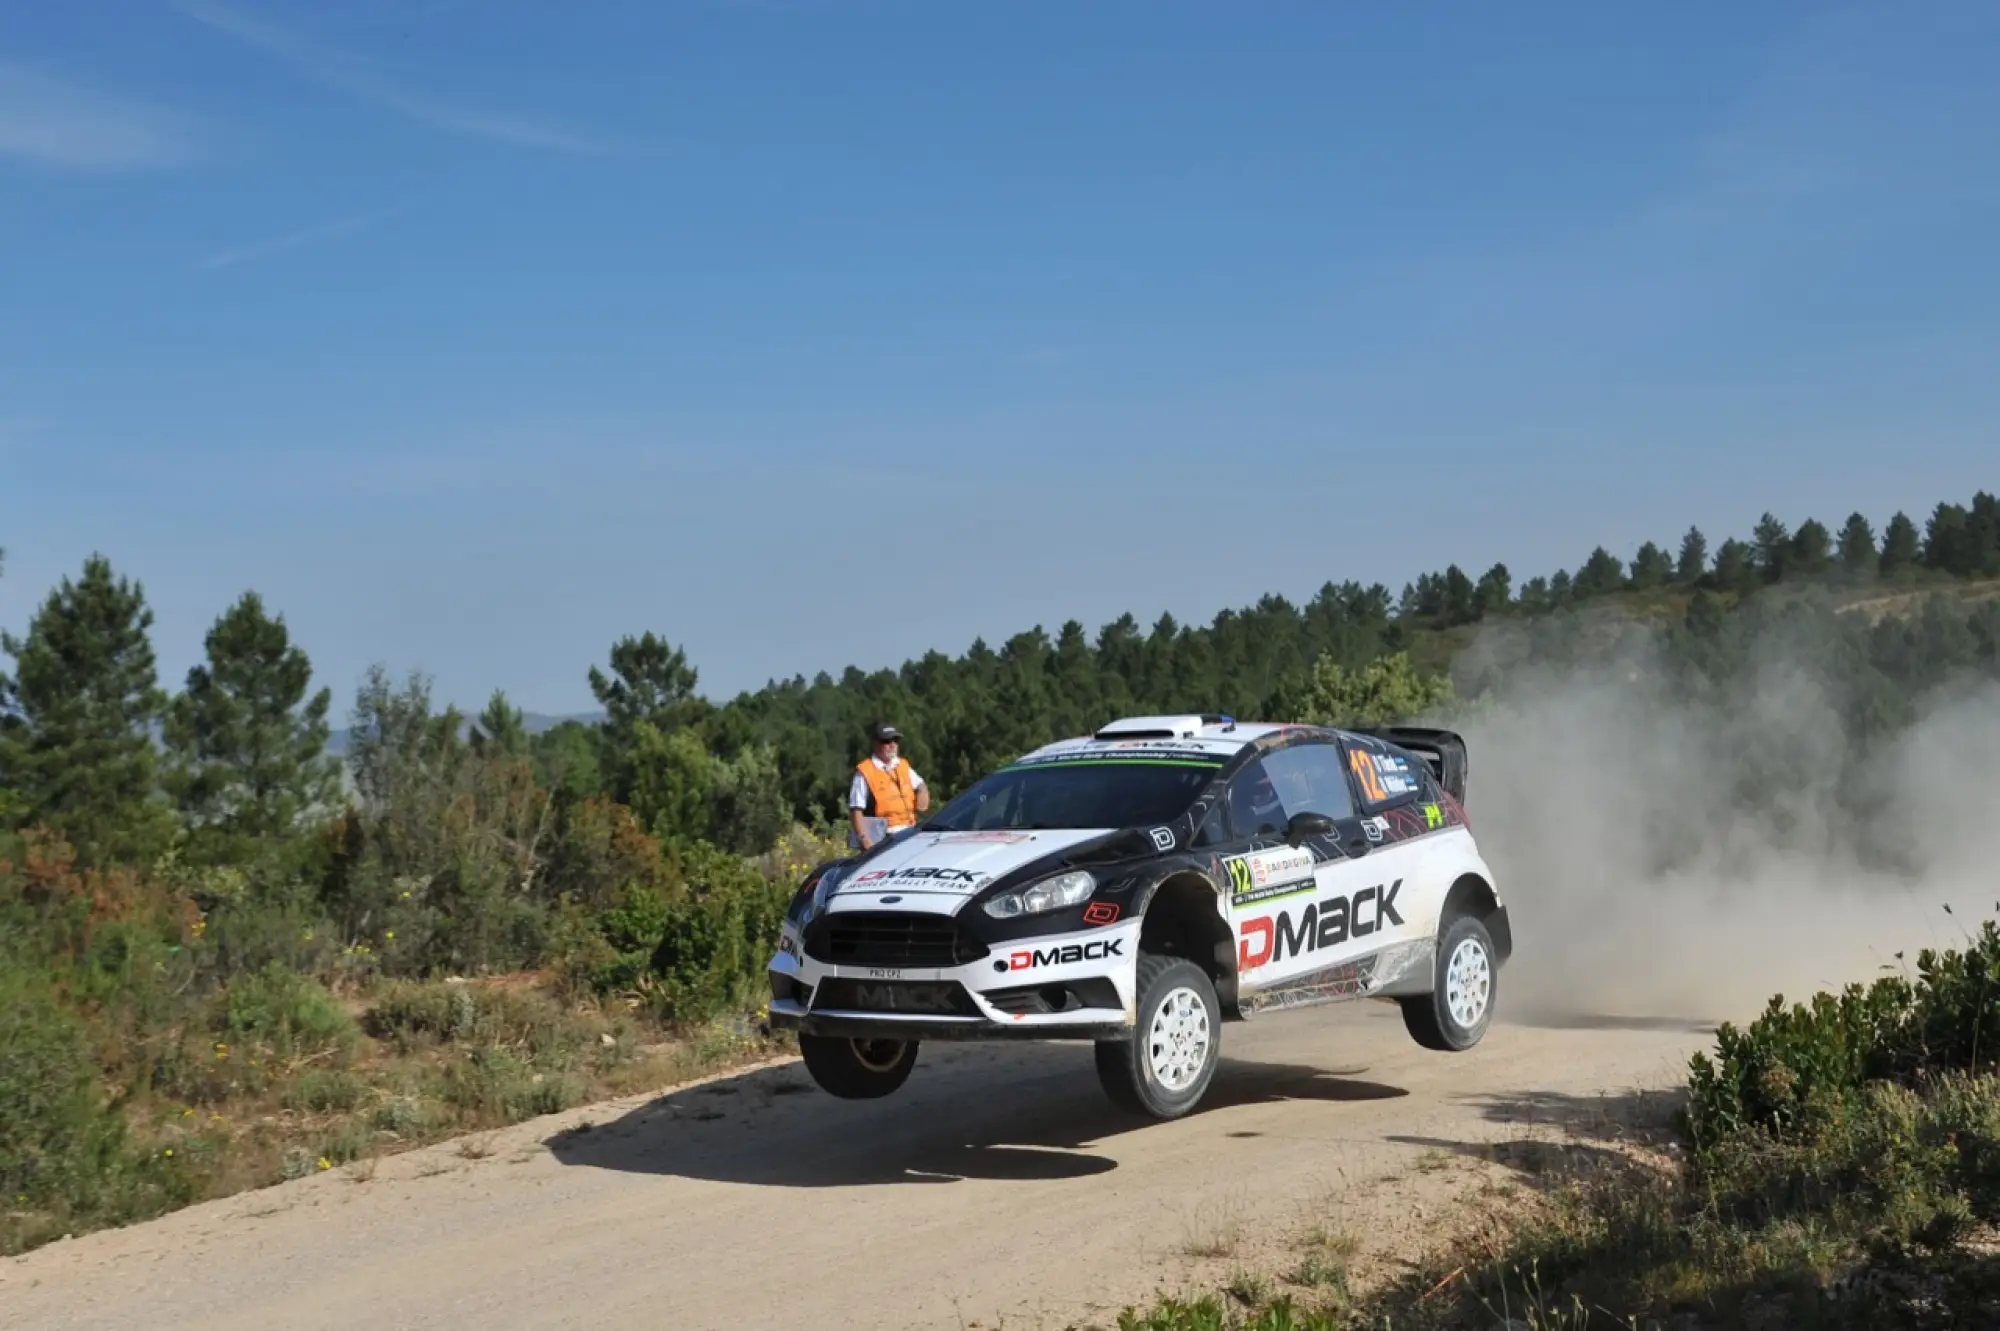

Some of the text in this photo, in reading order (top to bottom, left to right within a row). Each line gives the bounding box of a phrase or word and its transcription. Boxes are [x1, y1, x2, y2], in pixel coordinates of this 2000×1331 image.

[1349, 750, 1386, 800] 12
[1228, 857, 1250, 893] 12
[1237, 877, 1406, 973] DMACK
[1010, 938, 1124, 971] DMACK
